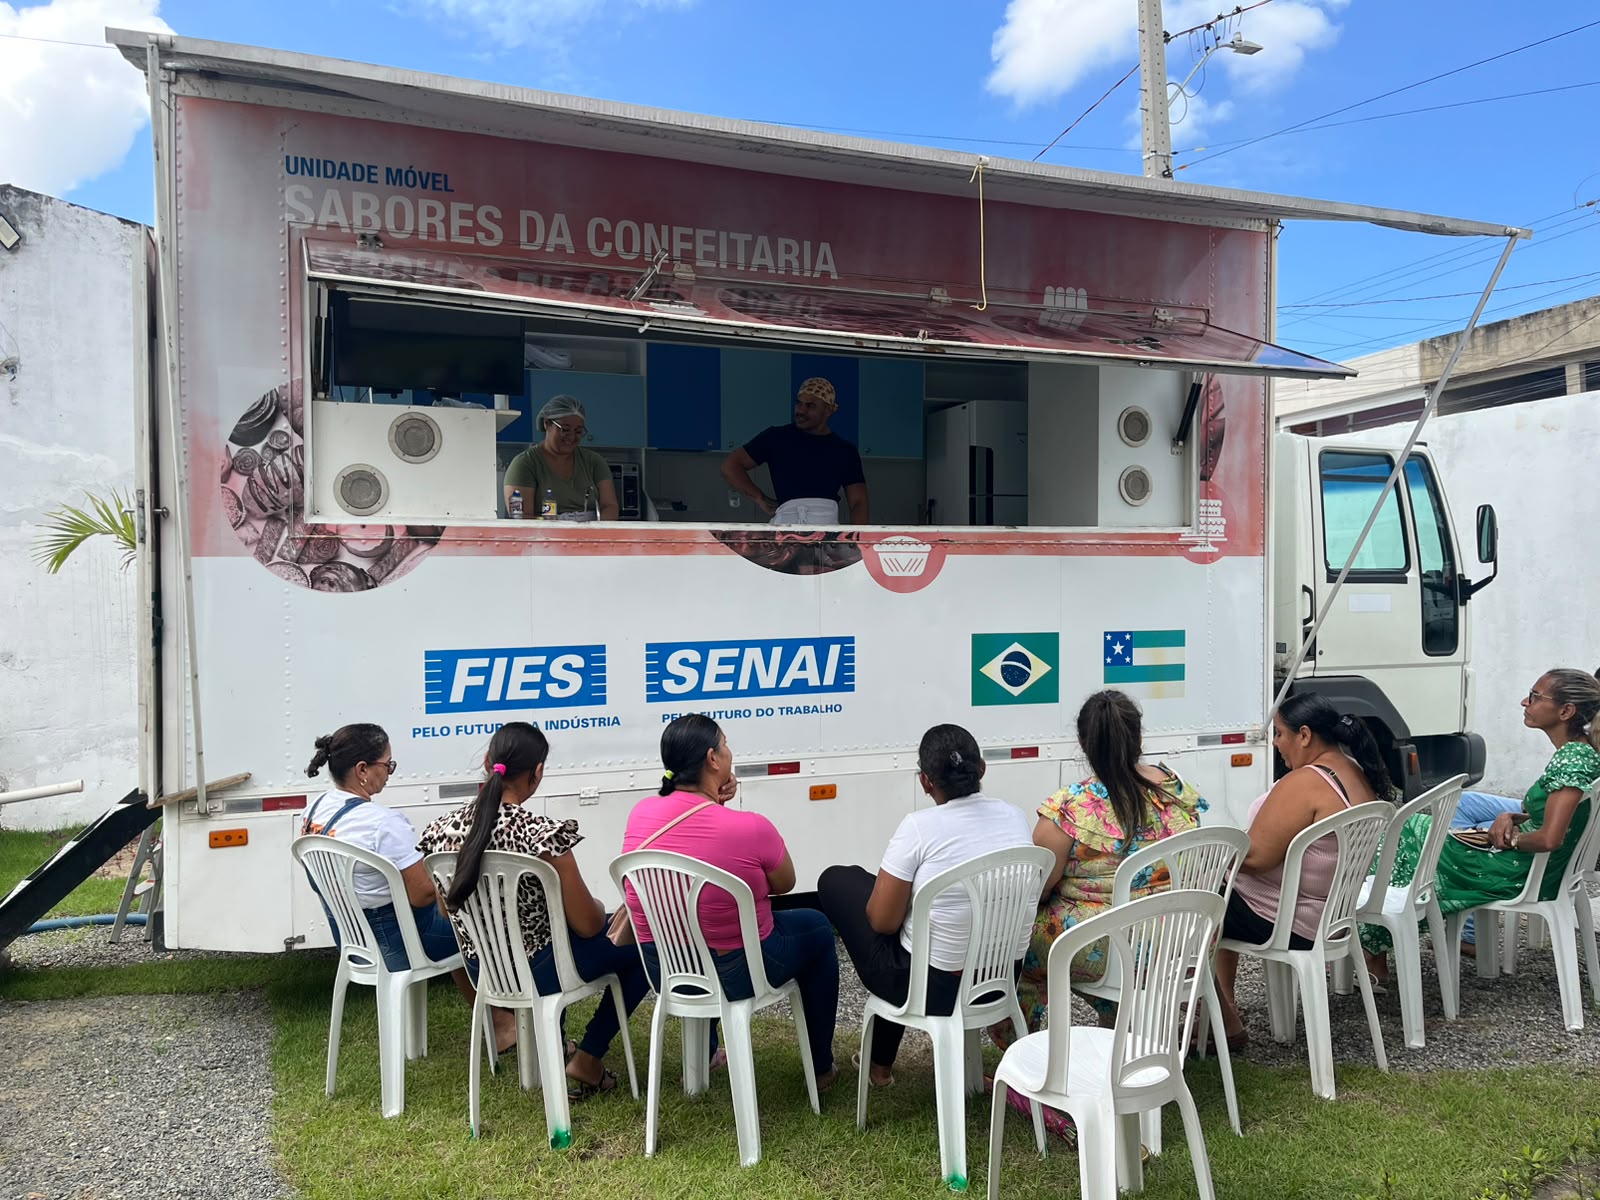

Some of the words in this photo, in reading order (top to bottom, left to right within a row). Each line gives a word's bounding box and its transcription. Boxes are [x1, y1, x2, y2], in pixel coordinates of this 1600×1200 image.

[284, 155, 378, 185] UNIDADE
[385, 164, 454, 193] MÓVEL
[282, 184, 504, 247] SABORES
[519, 209, 575, 254] DA
[586, 216, 840, 280] CONFEITARIA
[449, 653, 586, 704] FIES
[660, 643, 842, 695] SENAI
[412, 725, 451, 738] PELO
[455, 723, 504, 736] FUTUR
[545, 715, 621, 731] INDÚSTRIA
[755, 706, 775, 718] DO
[778, 703, 843, 716] TRABALHO
